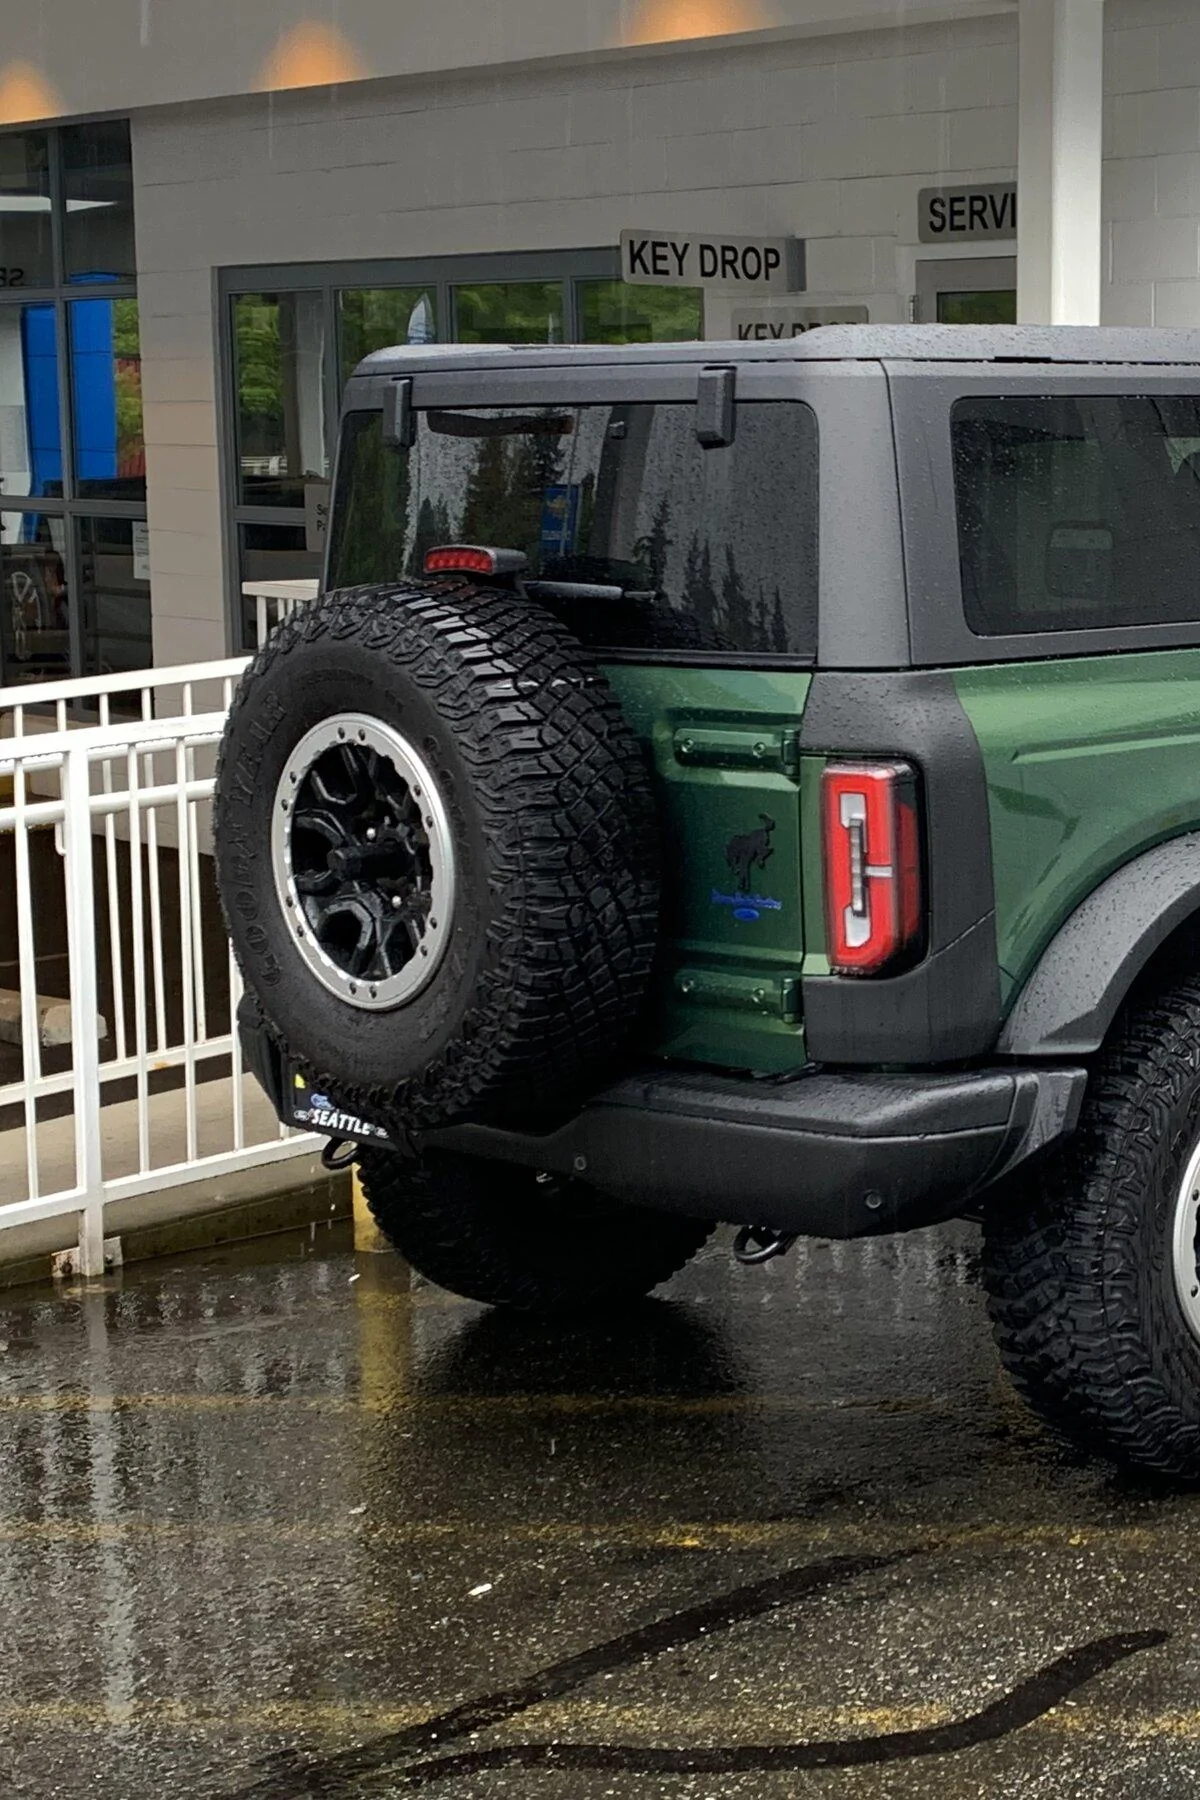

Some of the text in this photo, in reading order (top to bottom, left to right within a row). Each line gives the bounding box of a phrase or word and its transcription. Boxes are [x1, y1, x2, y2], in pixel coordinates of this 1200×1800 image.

[928, 192, 1016, 233] SERVI
[629, 240, 782, 281] KEY DROP
[311, 1108, 371, 1136] SEATTLE
